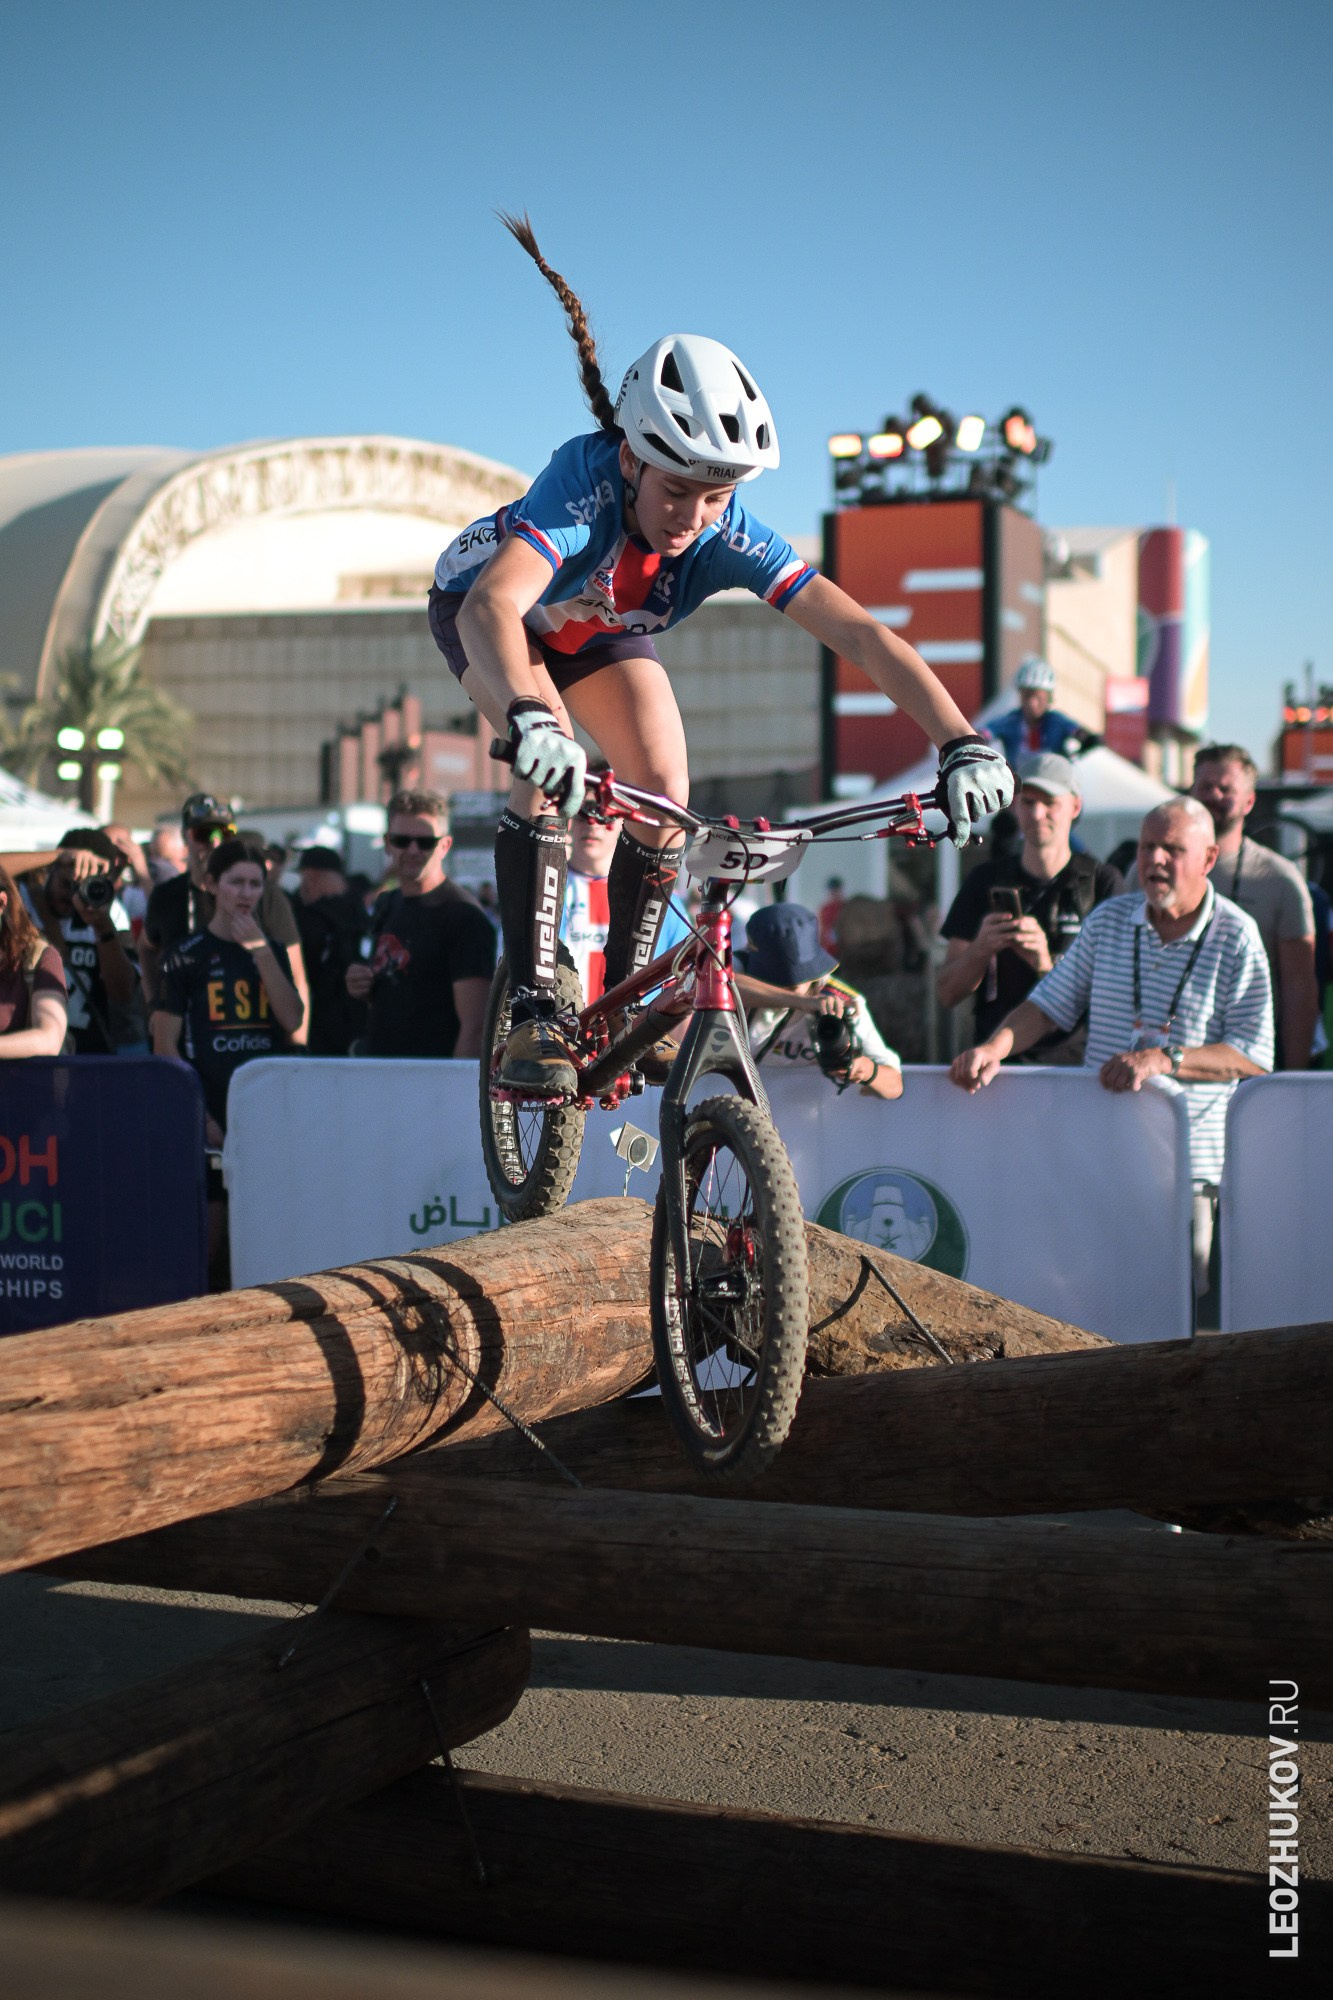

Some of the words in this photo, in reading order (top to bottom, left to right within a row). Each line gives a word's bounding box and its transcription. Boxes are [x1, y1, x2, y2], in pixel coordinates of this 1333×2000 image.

[706, 465, 738, 479] TRIAL
[720, 851, 769, 870] 5D
[535, 865, 559, 980] hebo
